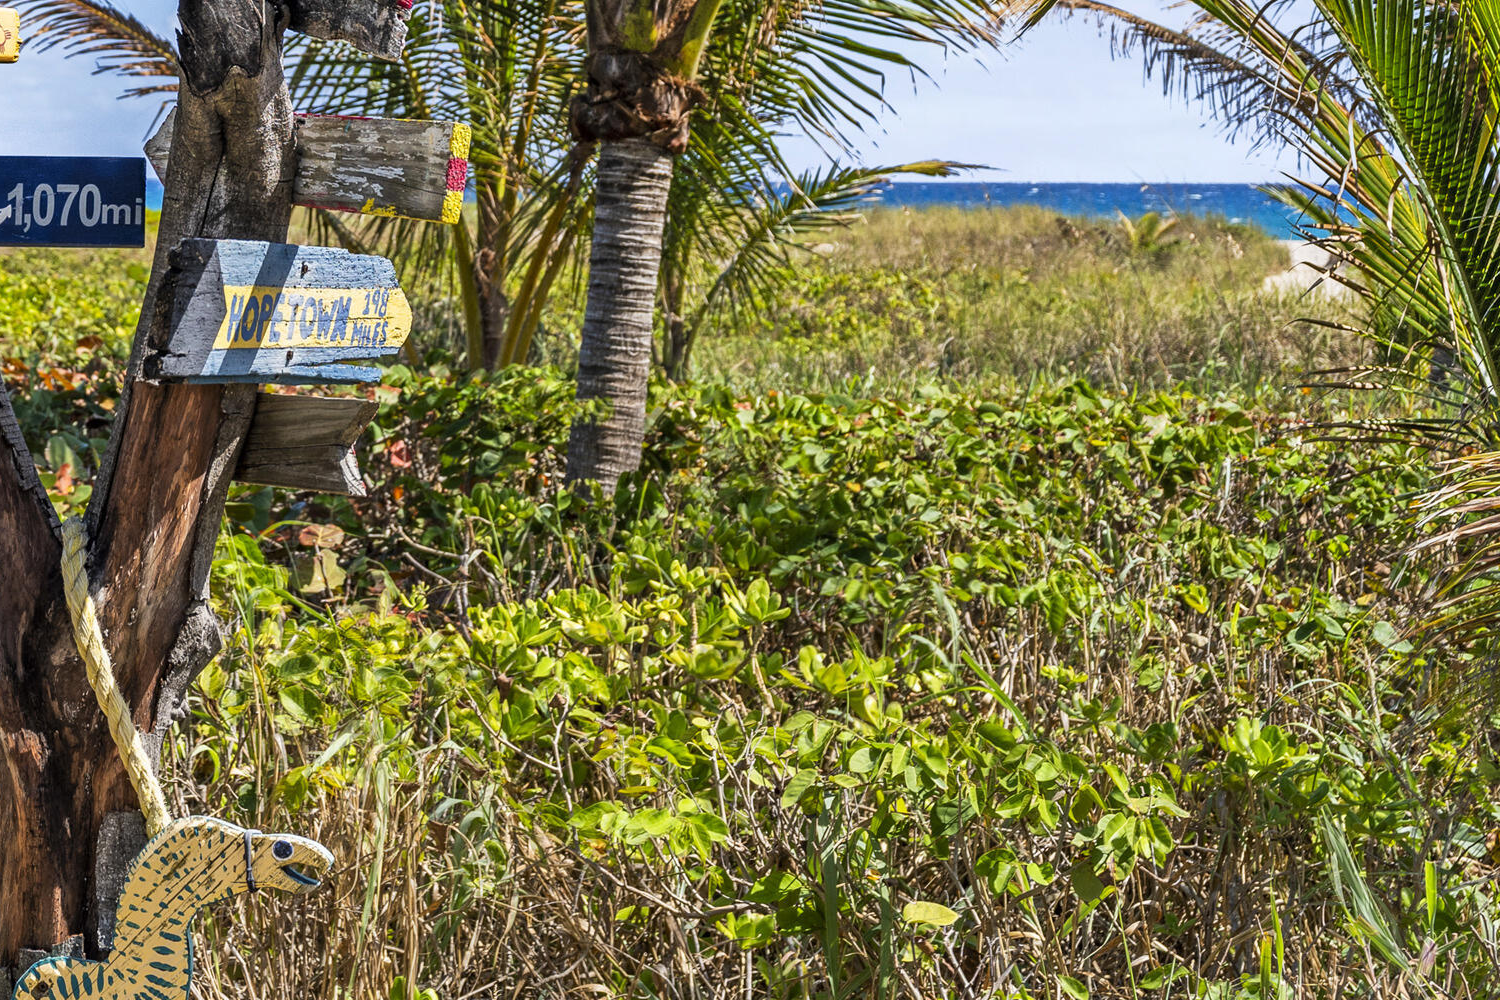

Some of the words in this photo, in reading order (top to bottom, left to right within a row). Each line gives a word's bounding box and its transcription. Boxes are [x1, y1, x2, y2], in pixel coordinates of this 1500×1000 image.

[226, 293, 352, 343] HOPETOWN
[362, 288, 389, 318] 198
[351, 320, 389, 346] MILES
